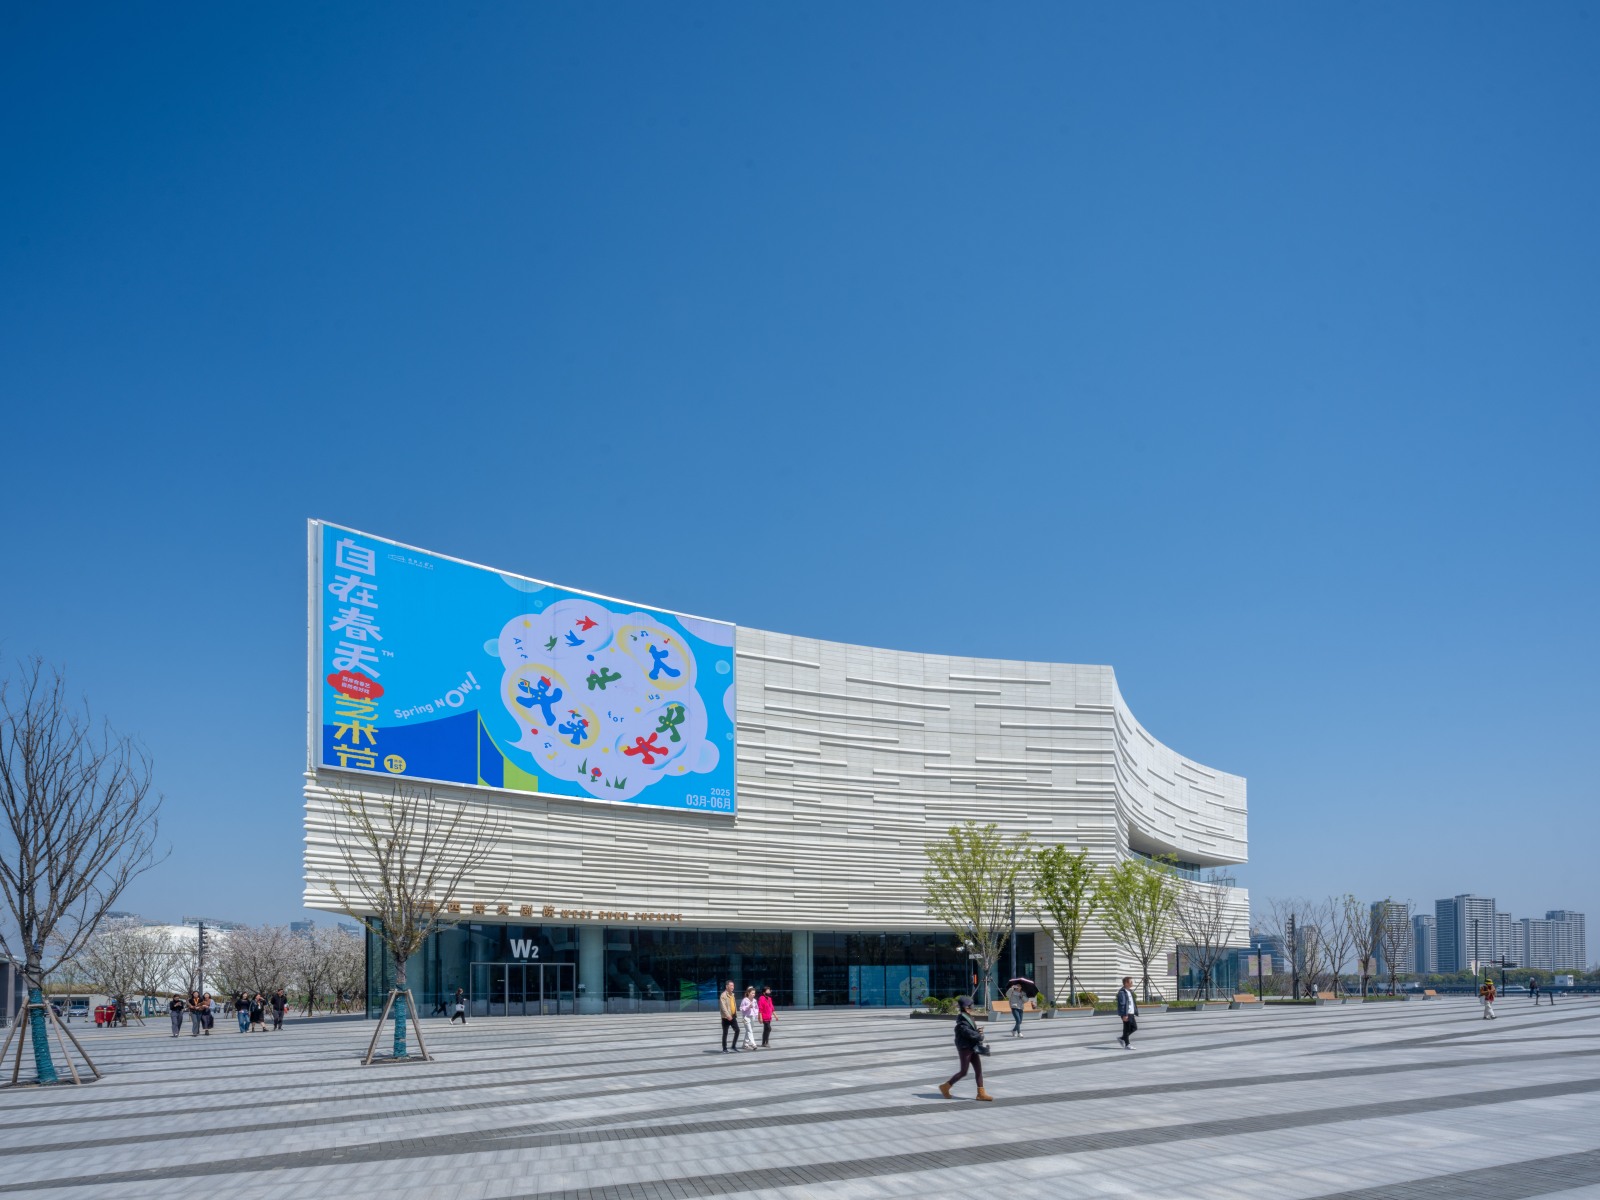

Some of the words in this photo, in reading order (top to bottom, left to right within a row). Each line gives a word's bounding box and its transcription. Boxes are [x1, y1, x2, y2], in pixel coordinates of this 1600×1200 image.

[393, 703, 434, 719] Spring
[434, 670, 481, 708] NOW!
[607, 710, 625, 723] for
[333, 692, 379, 769] 艺术节
[710, 787, 731, 797] 2025
[686, 793, 731, 810] 03月-06月
[447, 900, 556, 918] 西岸大剧院
[560, 909, 593, 920] WEST
[598, 910, 629, 921] BUND
[634, 911, 683, 921] THEATRE
[509, 938, 539, 959] W2
